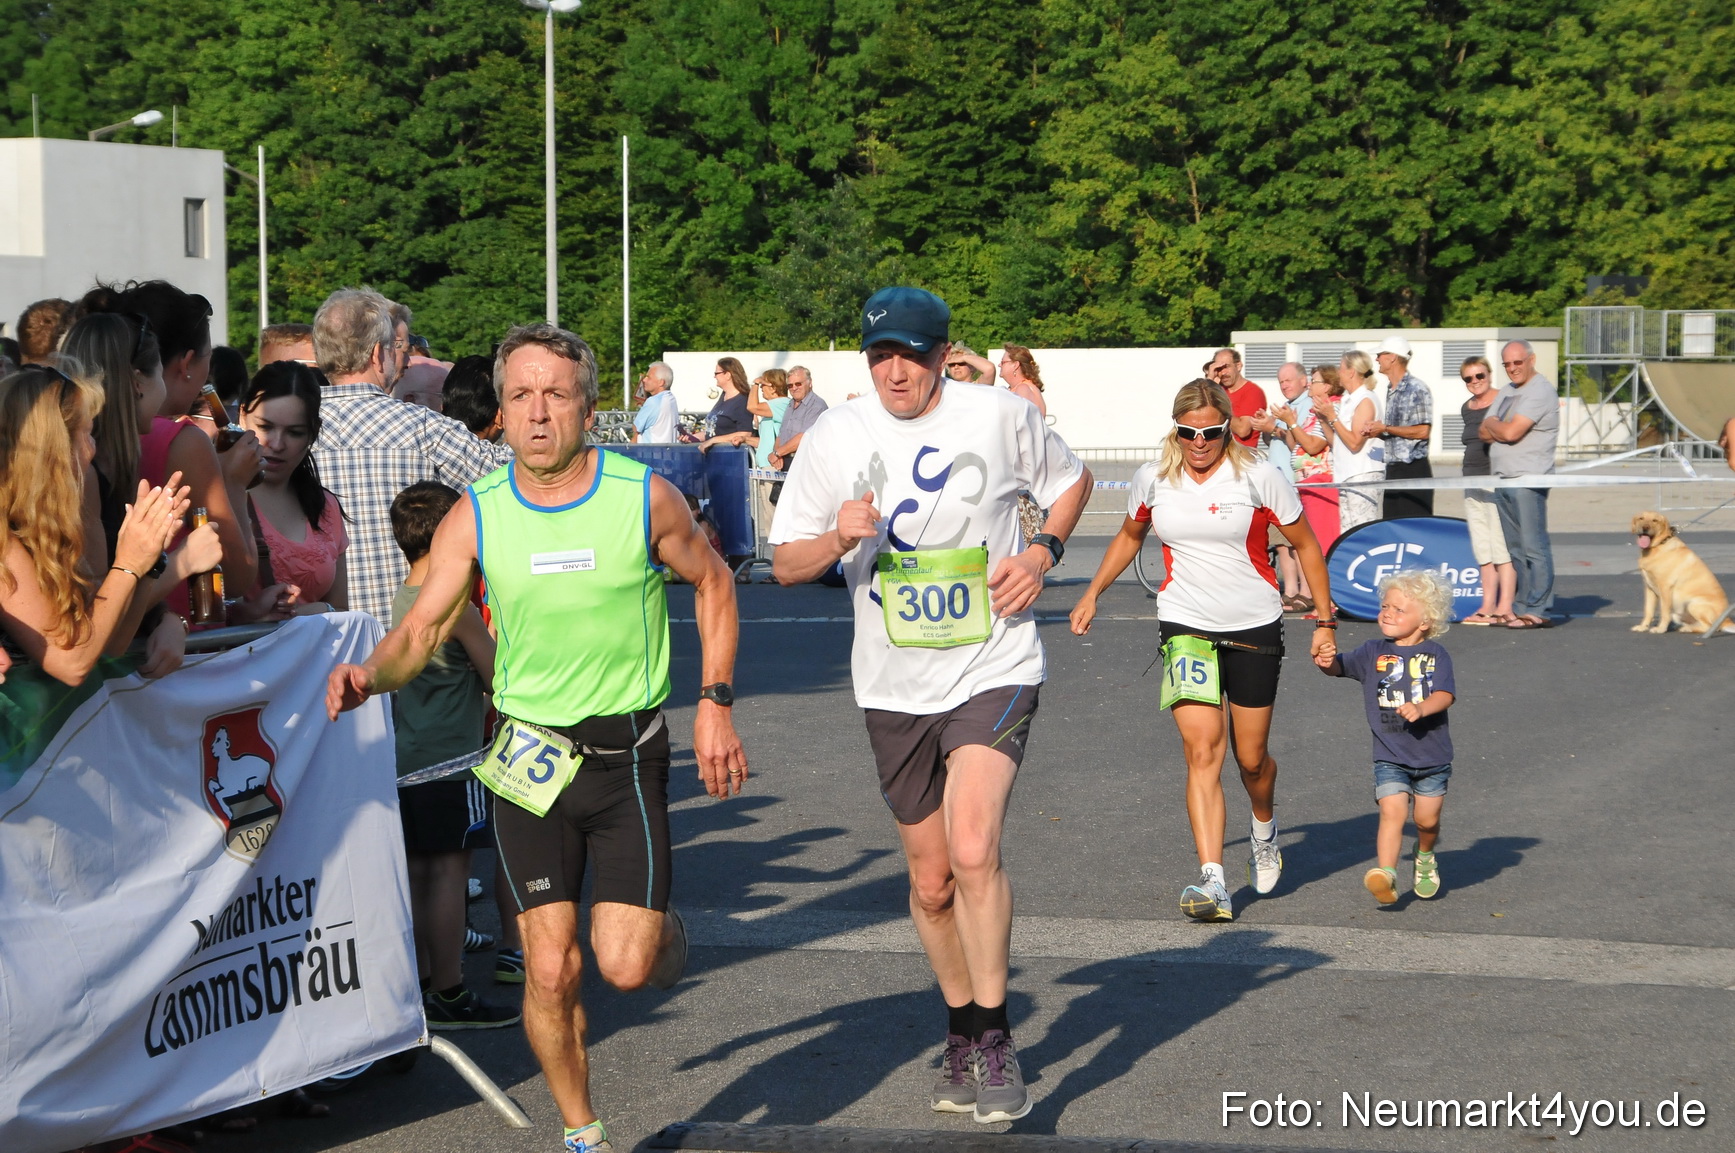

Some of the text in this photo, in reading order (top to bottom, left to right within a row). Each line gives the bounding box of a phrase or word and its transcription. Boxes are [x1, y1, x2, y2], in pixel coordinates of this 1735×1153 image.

[897, 582, 970, 622] 300
[1167, 656, 1208, 687] 115
[496, 723, 563, 784] 275
[513, 786, 530, 798] GmbH
[236, 822, 274, 853] 1628
[525, 877, 550, 888] DOUBLE
[527, 882, 551, 893] SPEED
[144, 927, 362, 1058] Lammsbräu
